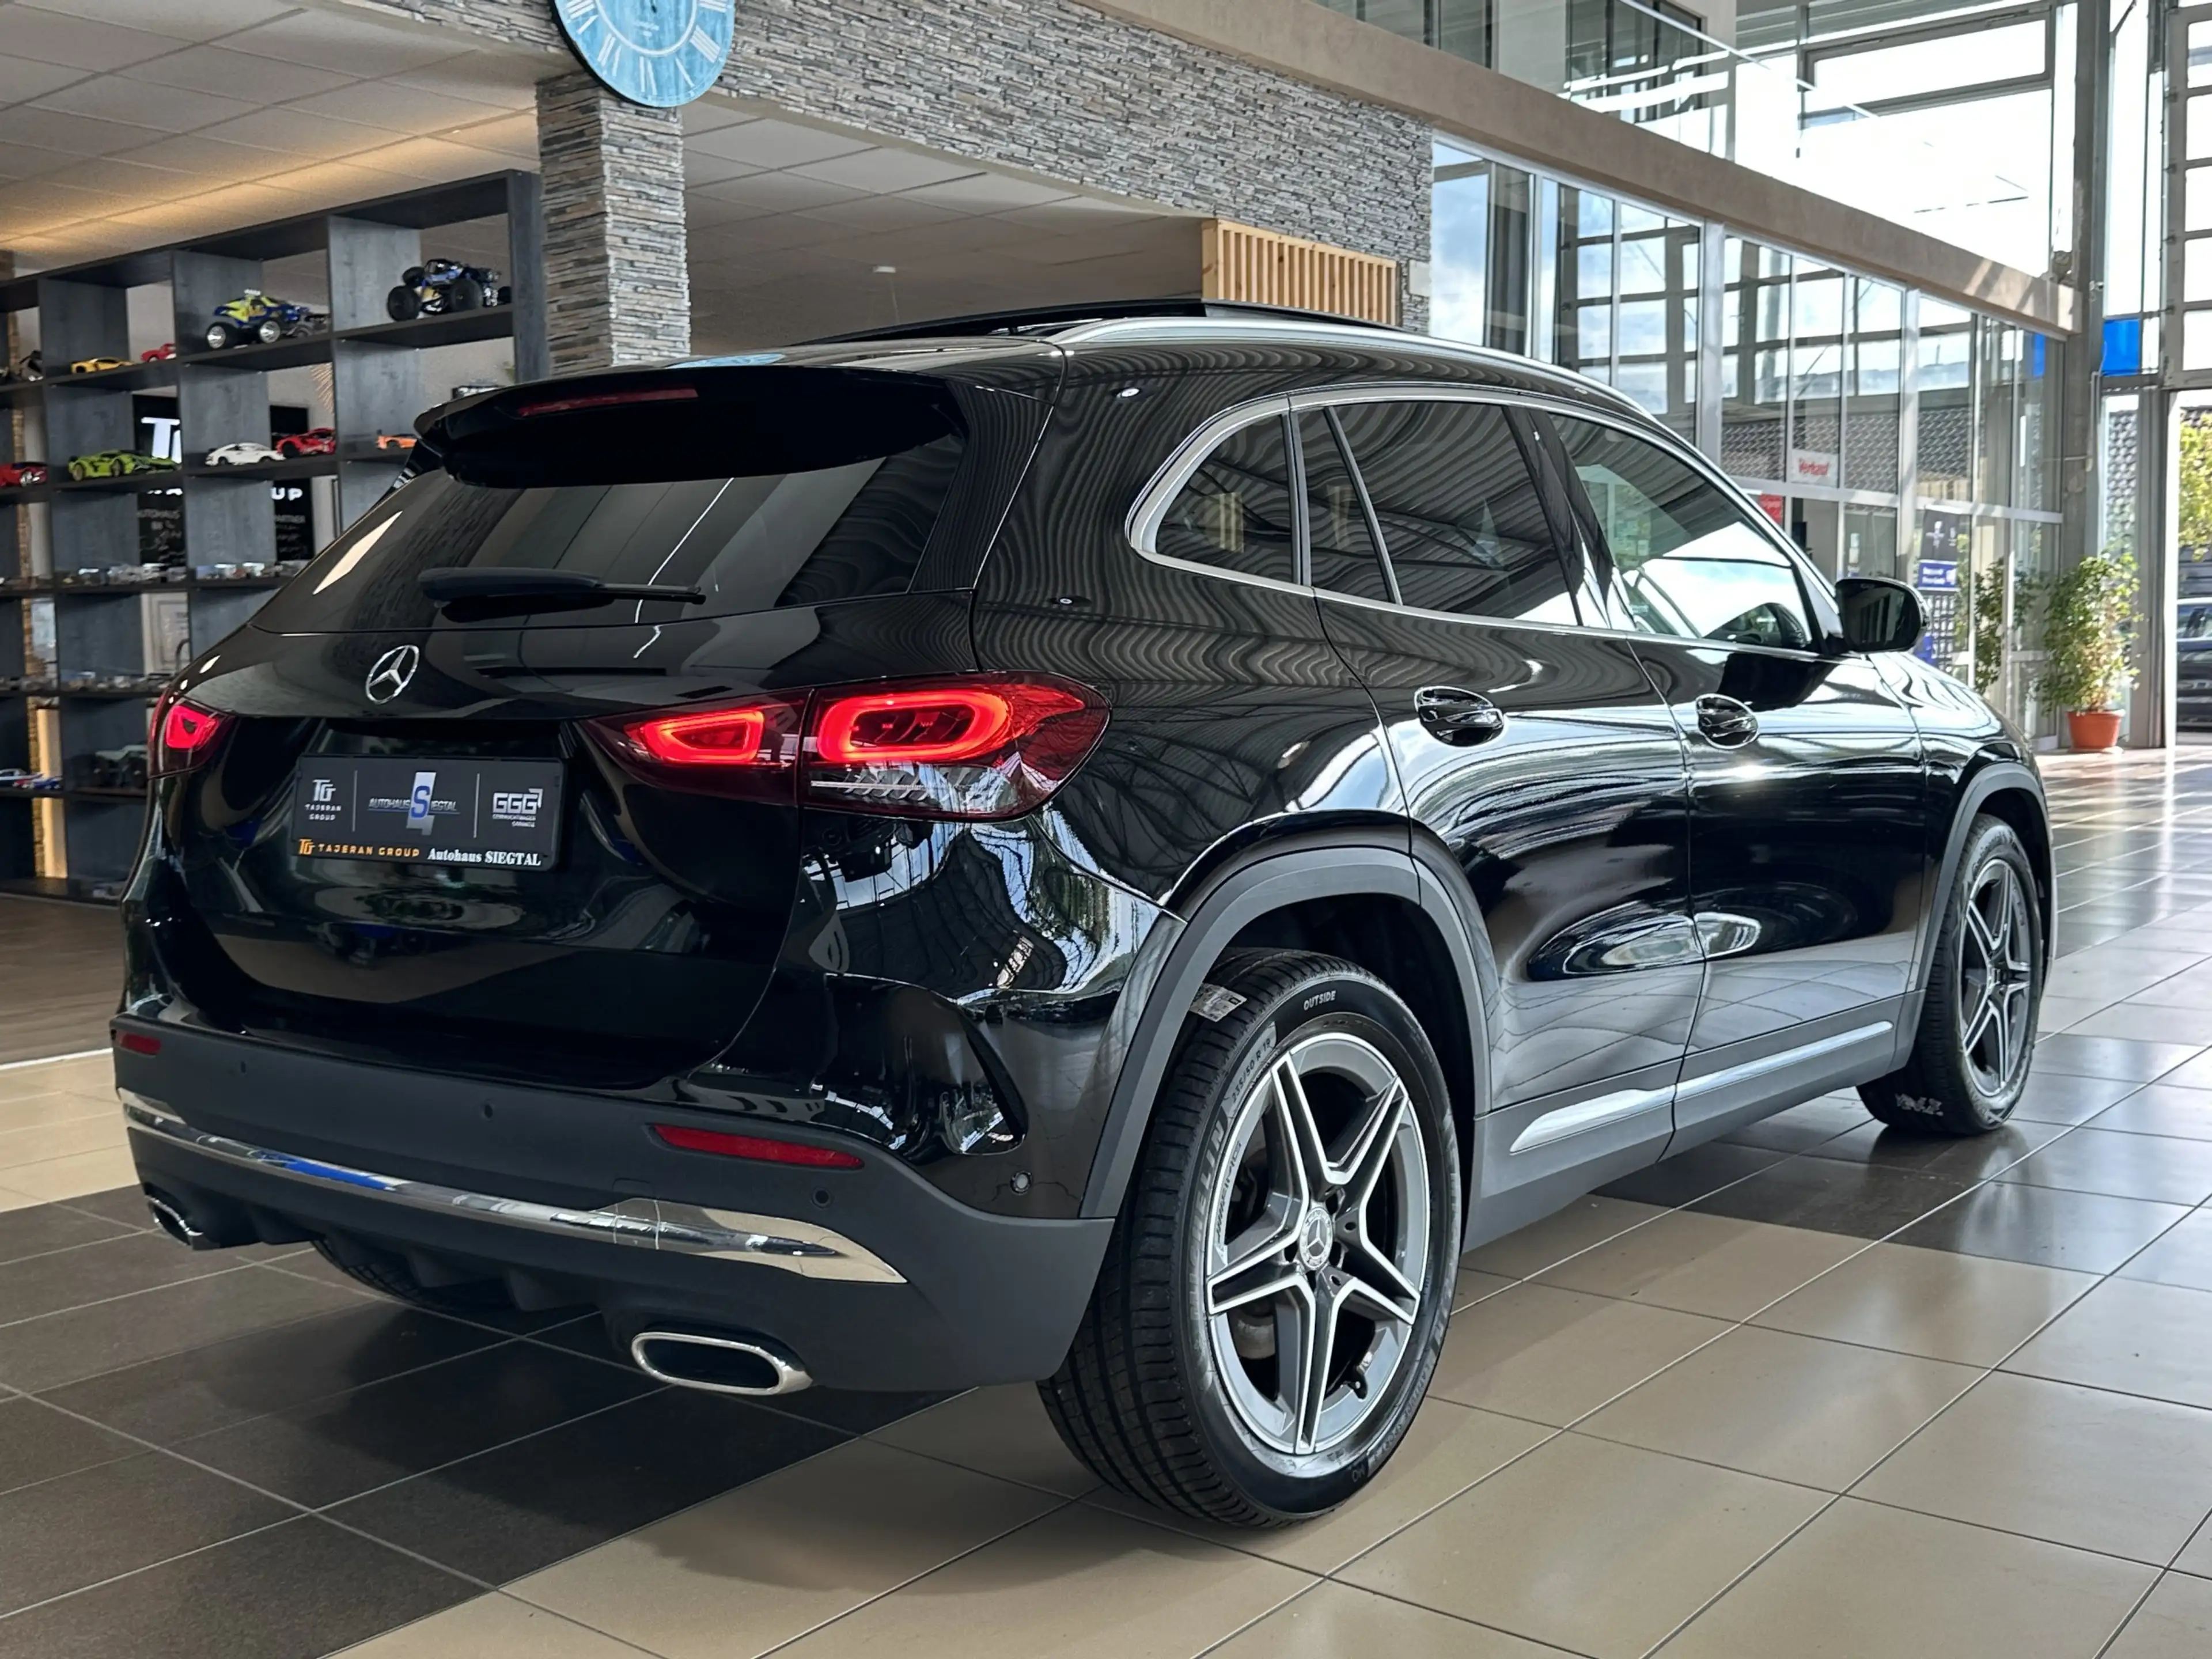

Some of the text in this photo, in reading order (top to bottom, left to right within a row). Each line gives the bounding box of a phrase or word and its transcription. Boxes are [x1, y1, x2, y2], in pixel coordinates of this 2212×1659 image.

[368, 797, 411, 809] AUTOHAUS
[317, 843, 373, 855] TAJERAN
[378, 847, 420, 857] GROUP
[427, 848, 541, 866] Autohaus SIEGTAL
[1303, 990, 1336, 1011] OUTSIDE
